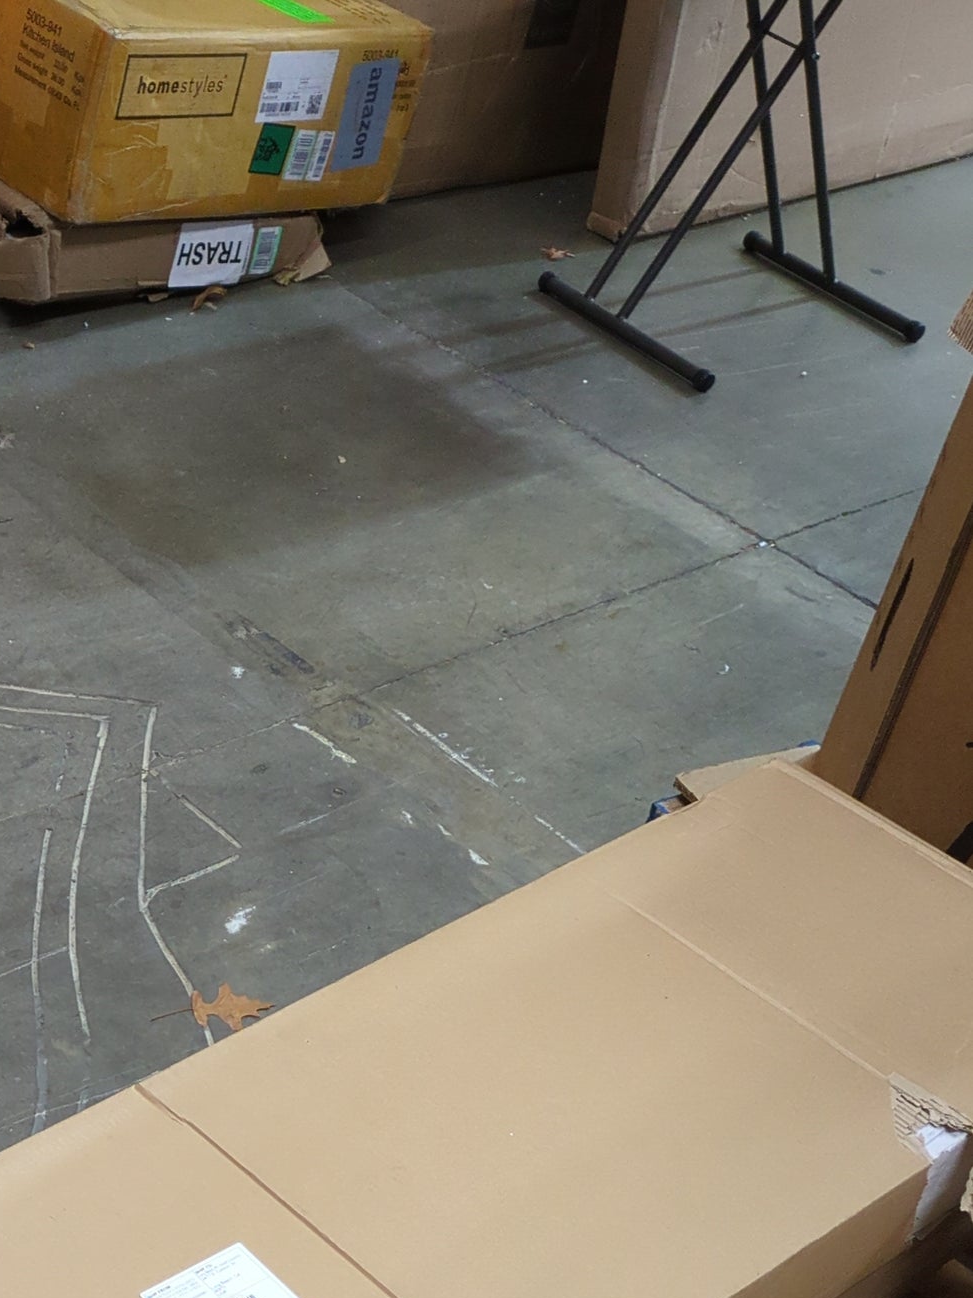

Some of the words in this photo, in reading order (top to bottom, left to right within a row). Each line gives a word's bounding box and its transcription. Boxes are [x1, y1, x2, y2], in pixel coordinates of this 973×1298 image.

[23, 23, 51, 48] Kitchen
[352, 67, 382, 160] amazon
[177, 241, 242, 266] TRASH
